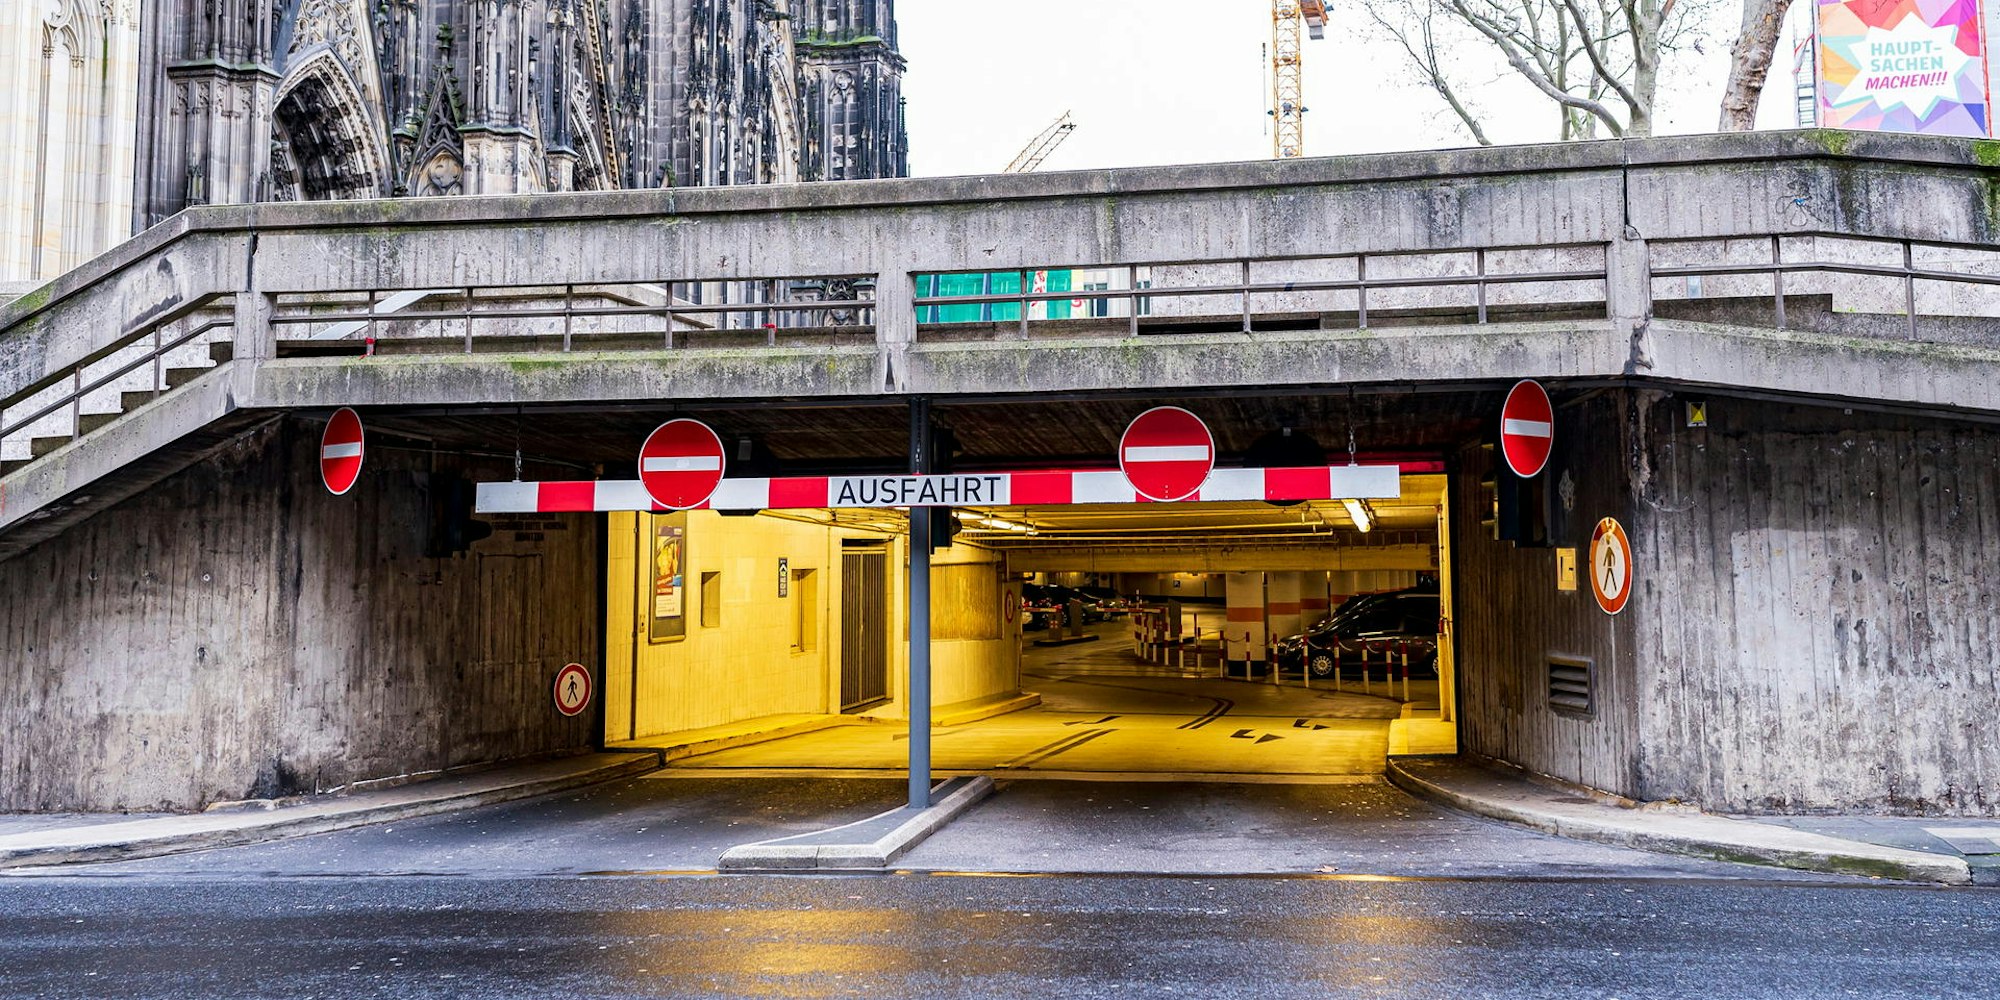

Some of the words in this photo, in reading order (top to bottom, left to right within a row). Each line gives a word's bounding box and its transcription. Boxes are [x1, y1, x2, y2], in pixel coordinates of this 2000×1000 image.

[1871, 41, 1942, 56] HAUPT-
[1871, 56, 1943, 72] SACHEN
[1866, 71, 1948, 90] MACHEN!!!
[837, 476, 1001, 505] AUSFAHRT
